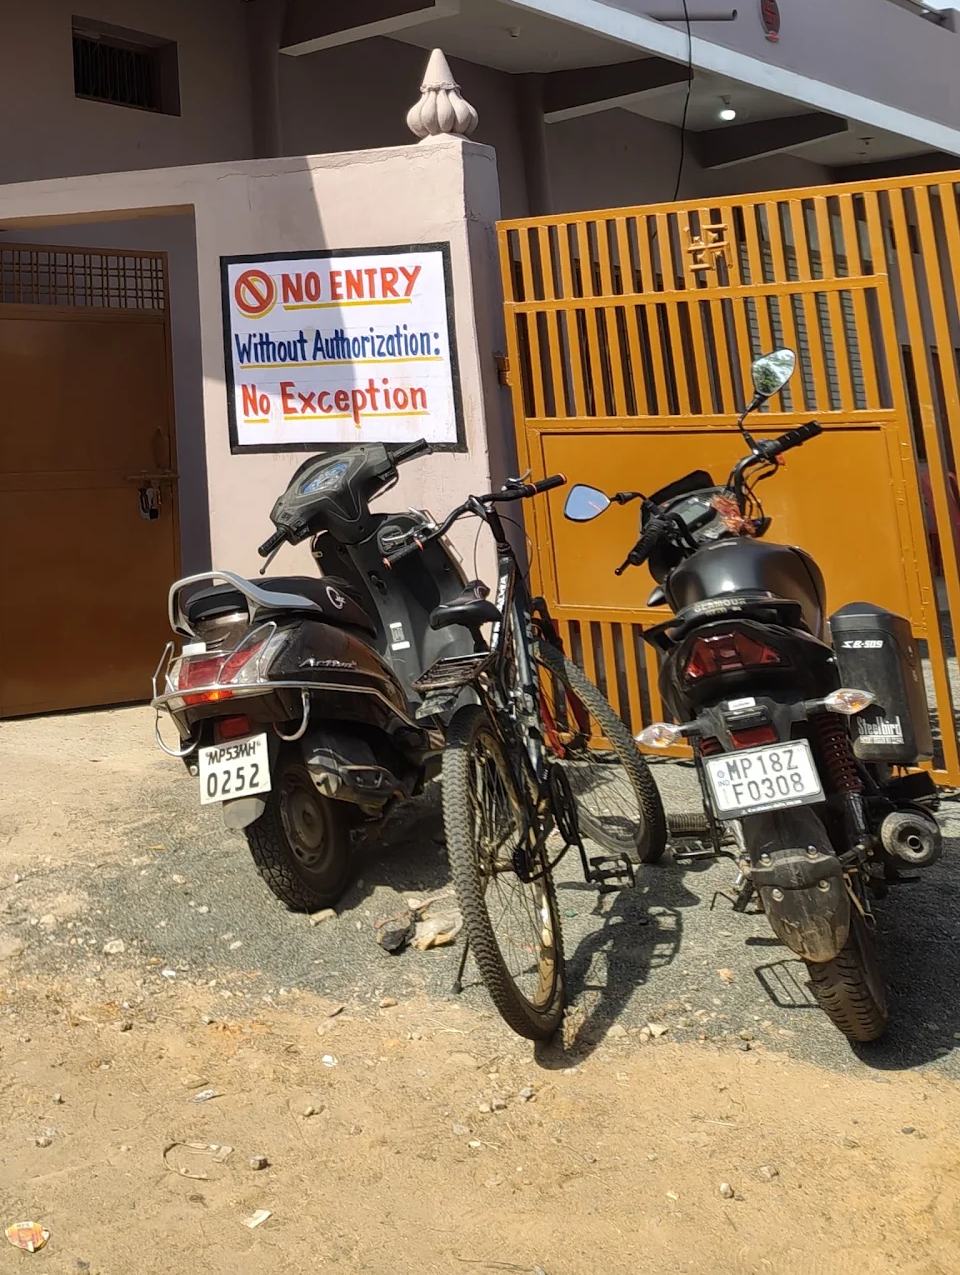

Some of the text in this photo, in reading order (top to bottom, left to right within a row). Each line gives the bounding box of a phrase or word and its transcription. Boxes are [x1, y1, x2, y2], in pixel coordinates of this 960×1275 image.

[282, 265, 422, 303] NO ENTRY
[234, 323, 441, 363] Without Authorization:
[241, 377, 428, 425] No Exception
[857, 715, 903, 735] Steelbird
[207, 763, 259, 797] 0252
[725, 749, 799, 780] MP18Z
[732, 772, 805, 804] F0308
